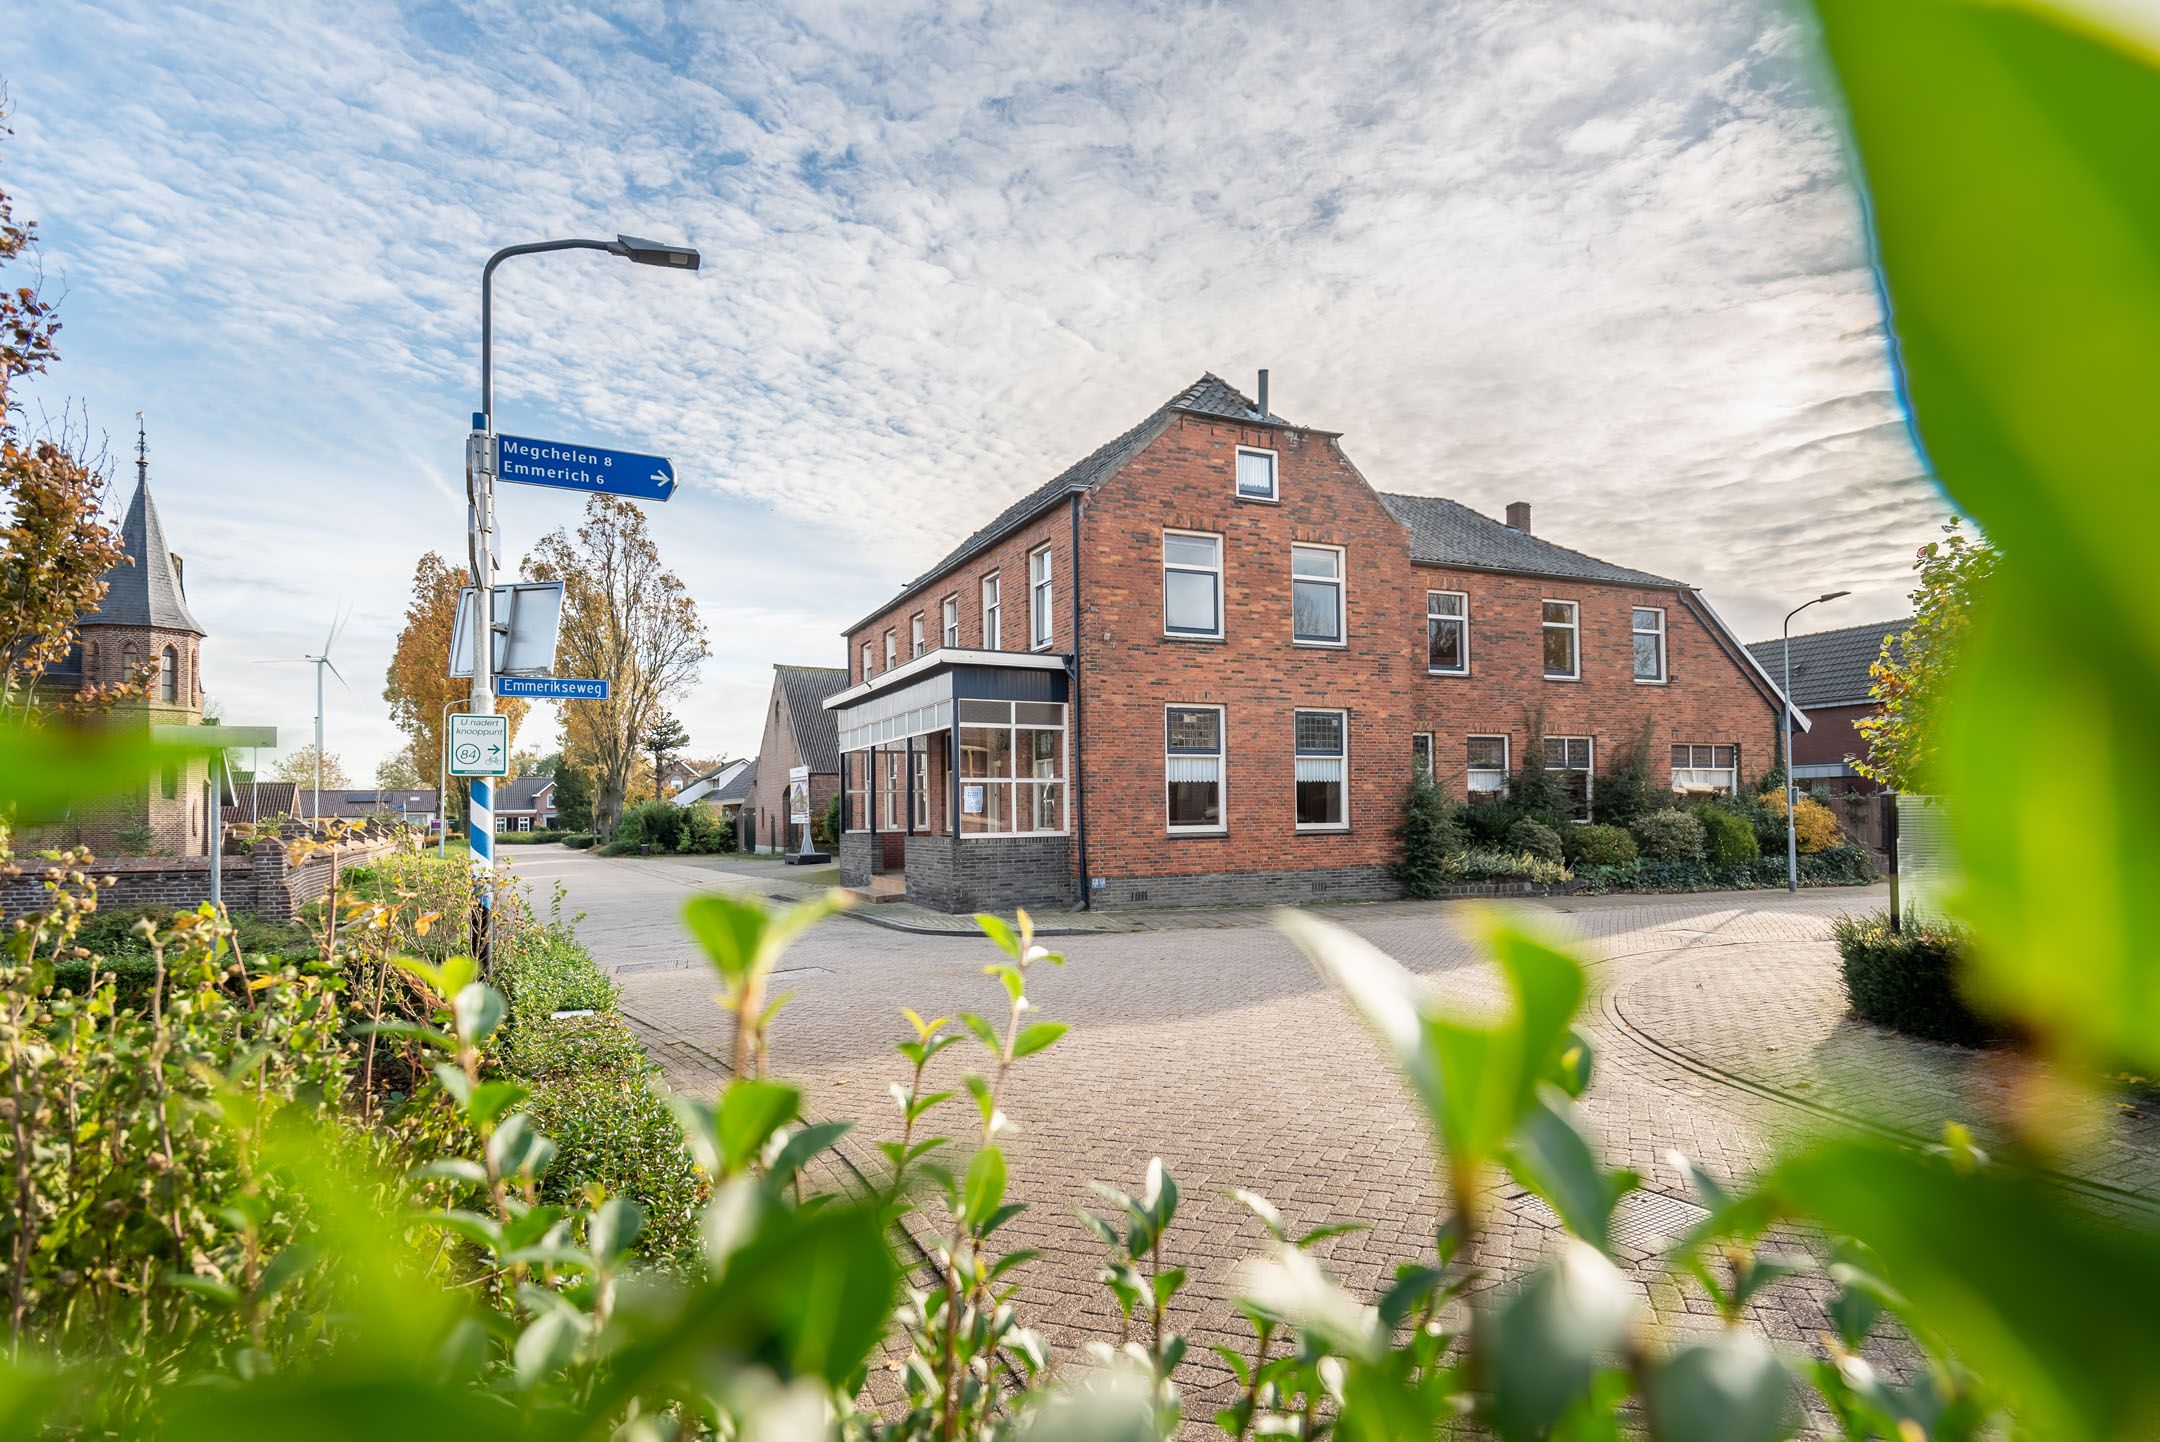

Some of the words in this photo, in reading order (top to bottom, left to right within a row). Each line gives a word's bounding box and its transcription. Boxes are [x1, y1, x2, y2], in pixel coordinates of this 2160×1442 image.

[503, 440, 598, 466] Megchelen
[603, 457, 613, 467] 8
[503, 460, 590, 483] Emmerich
[596, 474, 605, 485] 6
[504, 679, 602, 698] Emmerikseweg
[460, 718, 468, 726] U
[470, 719, 499, 727] nadert
[456, 728, 503, 736] knooppunt
[460, 749, 477, 760] 84
